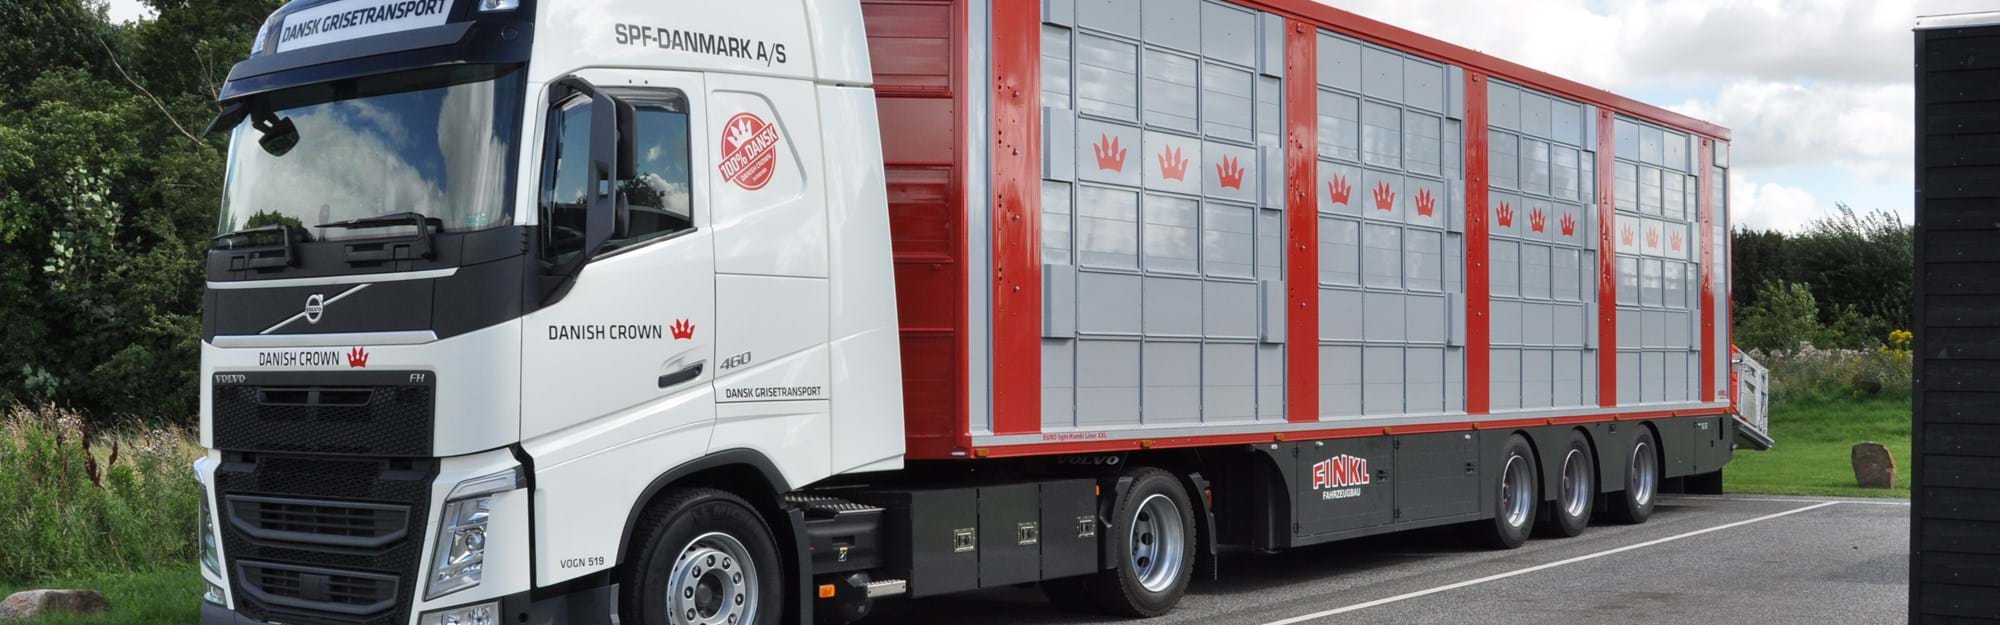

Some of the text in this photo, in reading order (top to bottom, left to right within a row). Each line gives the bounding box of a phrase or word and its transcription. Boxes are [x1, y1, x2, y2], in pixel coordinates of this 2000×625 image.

[282, 0, 445, 43] DANSK GRISETRANSPORT
[615, 23, 786, 67] SPF-DANMARK A/S
[720, 151, 748, 179] 100%
[745, 125, 778, 160] DANSK
[549, 324, 662, 340] DANISH CROWN
[259, 351, 340, 367] DANISH CROWN
[720, 352, 751, 371] 460
[215, 374, 246, 383] VOLVO
[409, 373, 425, 383] FH
[726, 386, 821, 398] DANSK GRISETRANSPORT
[1313, 454, 1370, 490] FINKL
[1323, 488, 1361, 500] FAHRZEUGBAU
[560, 556, 605, 568] VOGN 519
